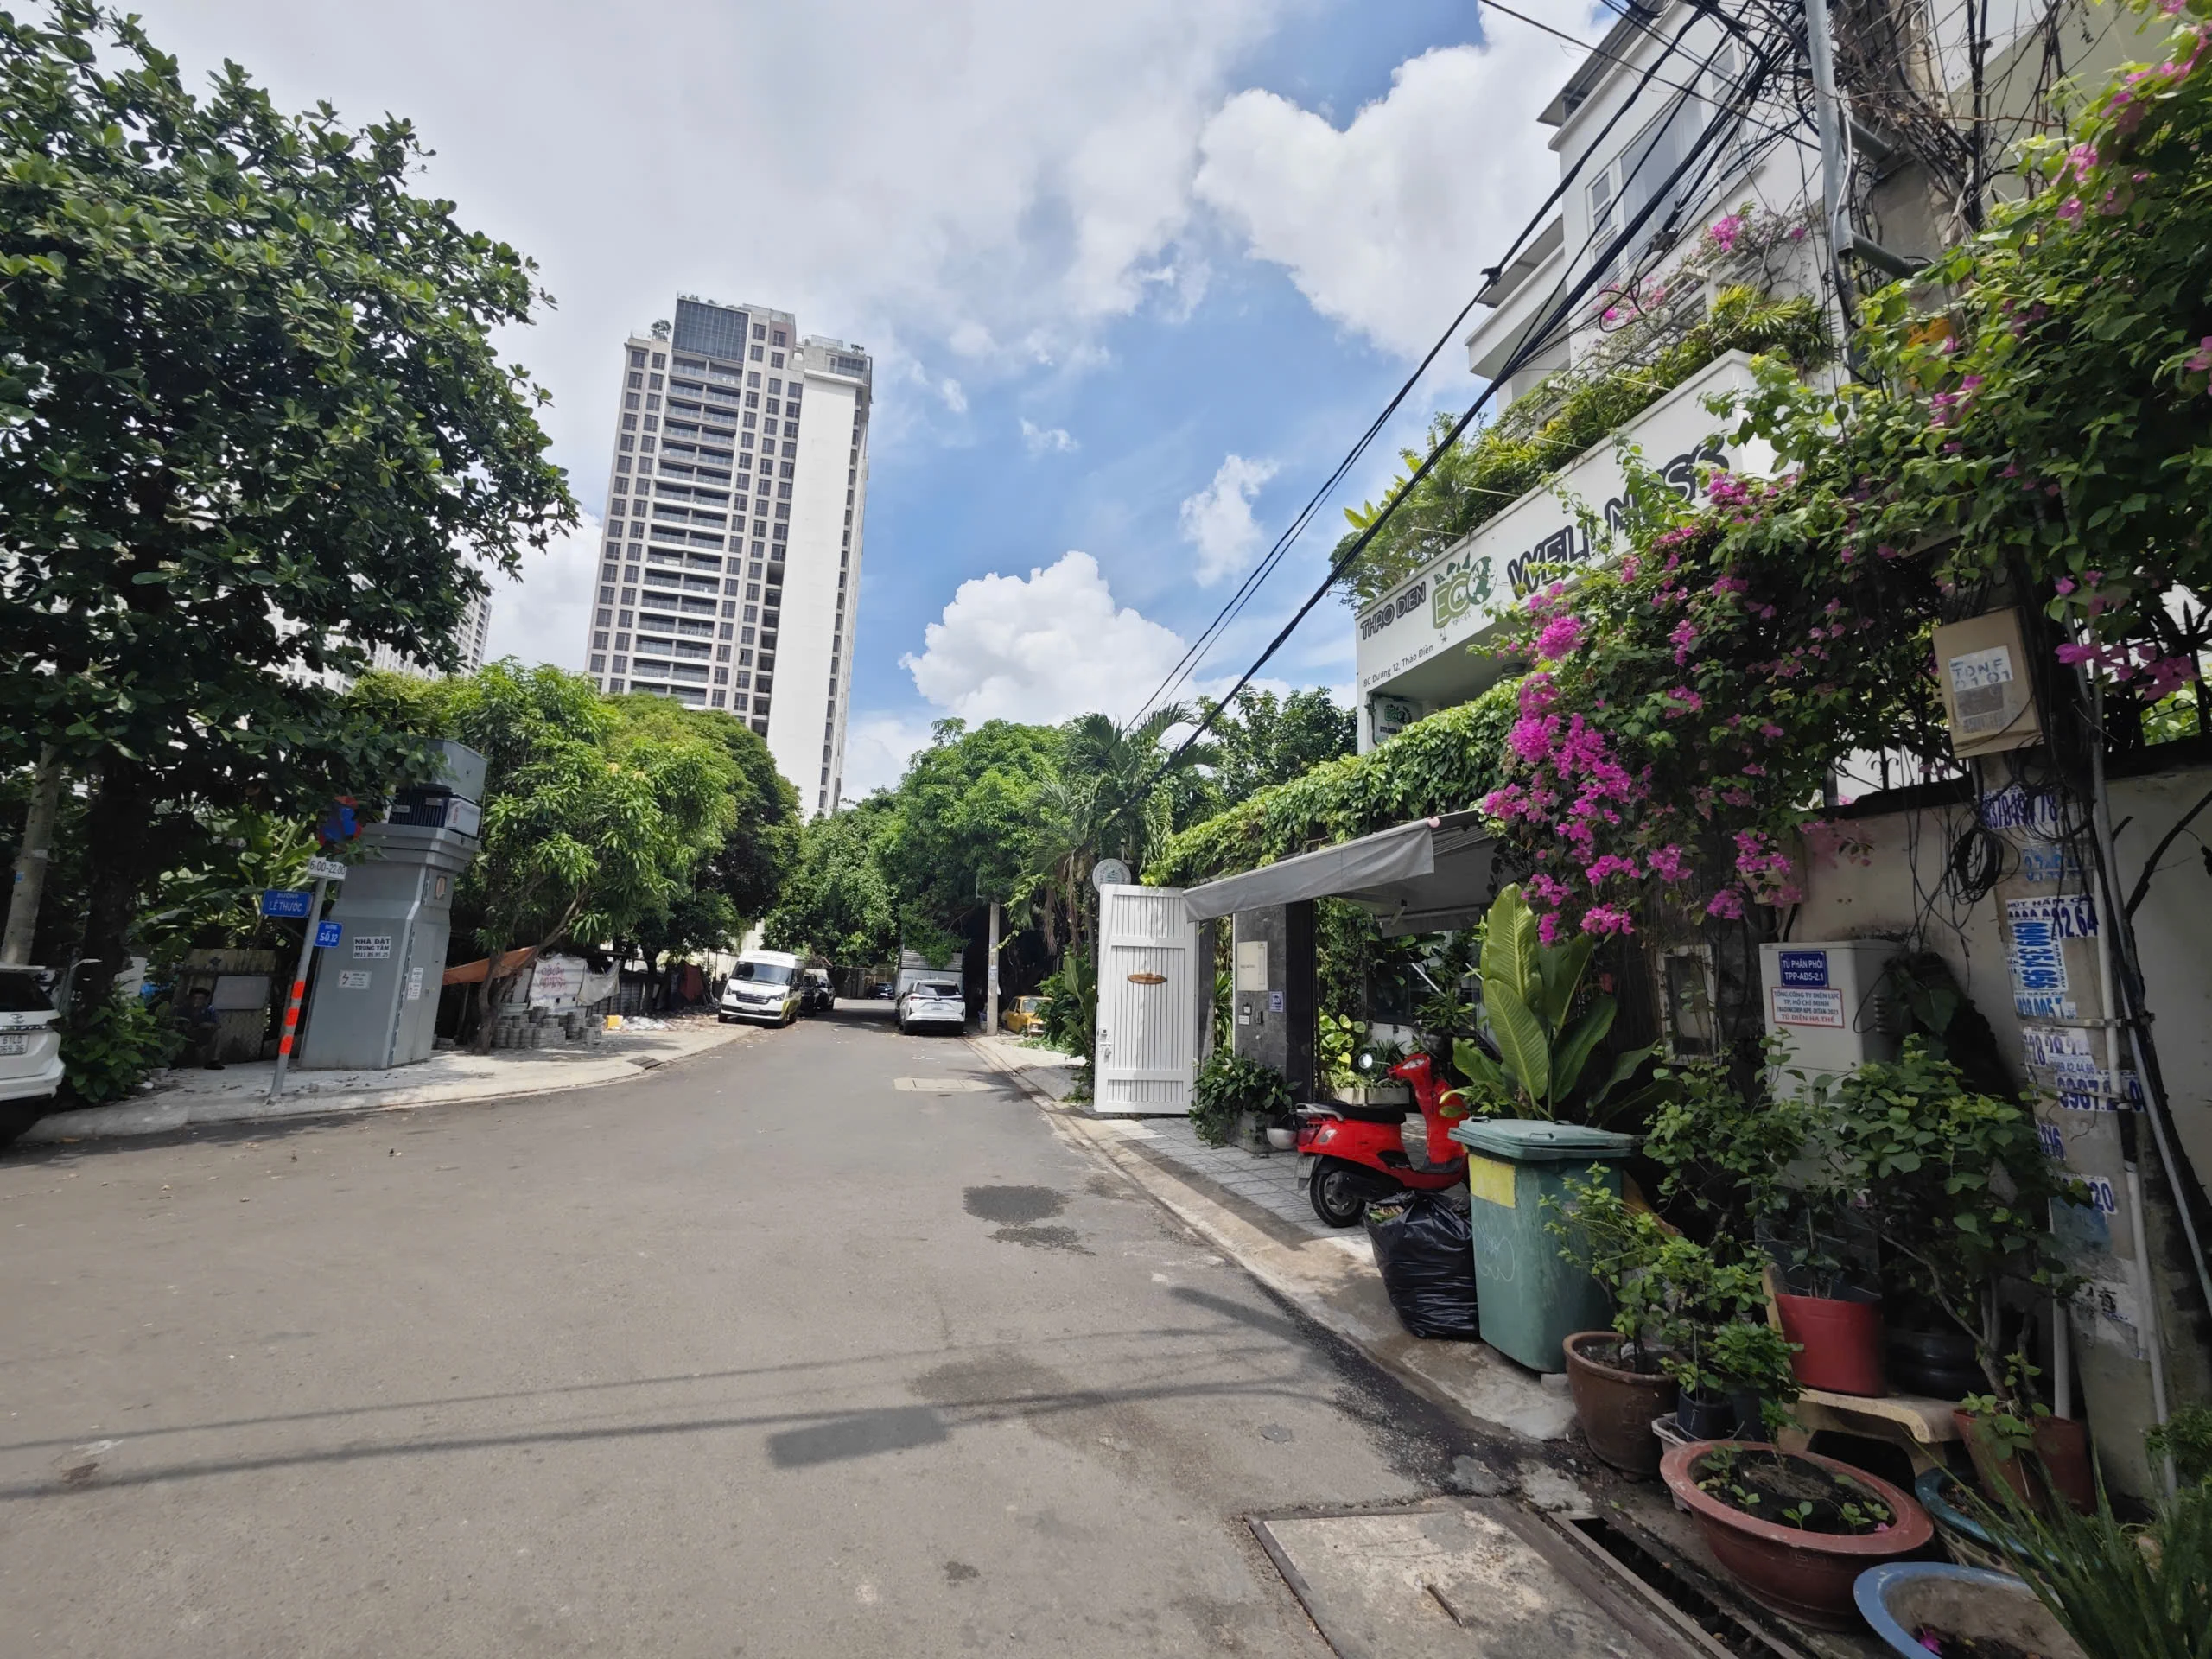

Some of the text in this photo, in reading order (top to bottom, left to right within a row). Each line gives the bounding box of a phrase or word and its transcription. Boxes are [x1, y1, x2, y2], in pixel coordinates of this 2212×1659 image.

[1360, 603, 1395, 640] THAO
[1396, 581, 1427, 619] DIEN
[1432, 556, 1498, 630] ECO
